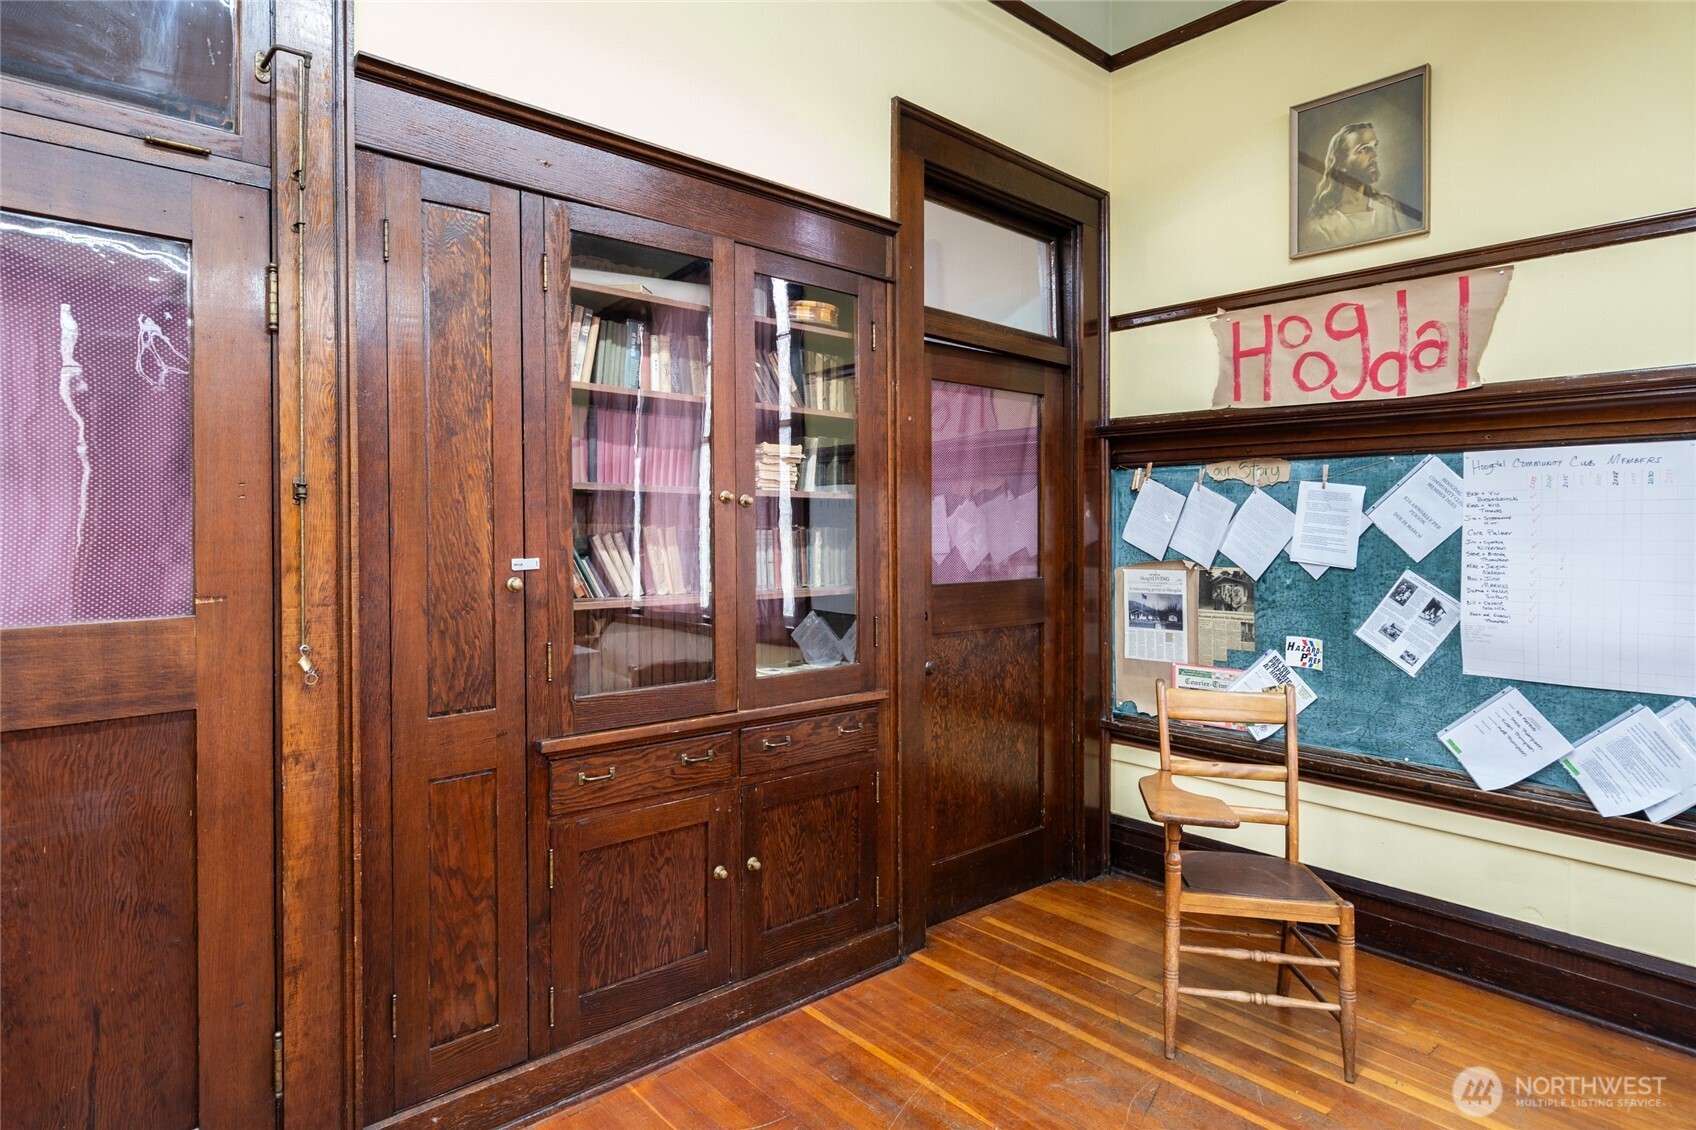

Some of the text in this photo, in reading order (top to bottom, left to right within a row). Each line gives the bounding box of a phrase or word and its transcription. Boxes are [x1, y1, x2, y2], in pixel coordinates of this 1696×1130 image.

[1232, 276, 1469, 401] Hoogdal
[1214, 461, 1280, 483] our Story
[1472, 460, 1506, 476] Hoogdal
[1513, 458, 1562, 468] COMMUNITY
[1607, 454, 1662, 464] MEMBERS
[1427, 482, 1447, 501] MEMBER
[1429, 475, 1453, 498] COMMUNITY
[1442, 477, 1462, 496] HOOGDAL
[1409, 509, 1425, 525] PERSON
[1407, 523, 1422, 539] MARCH
[1273, 655, 1291, 676] ARE YOU
[1300, 653, 1321, 664] PREP
[1268, 658, 1292, 684] PREPARE
